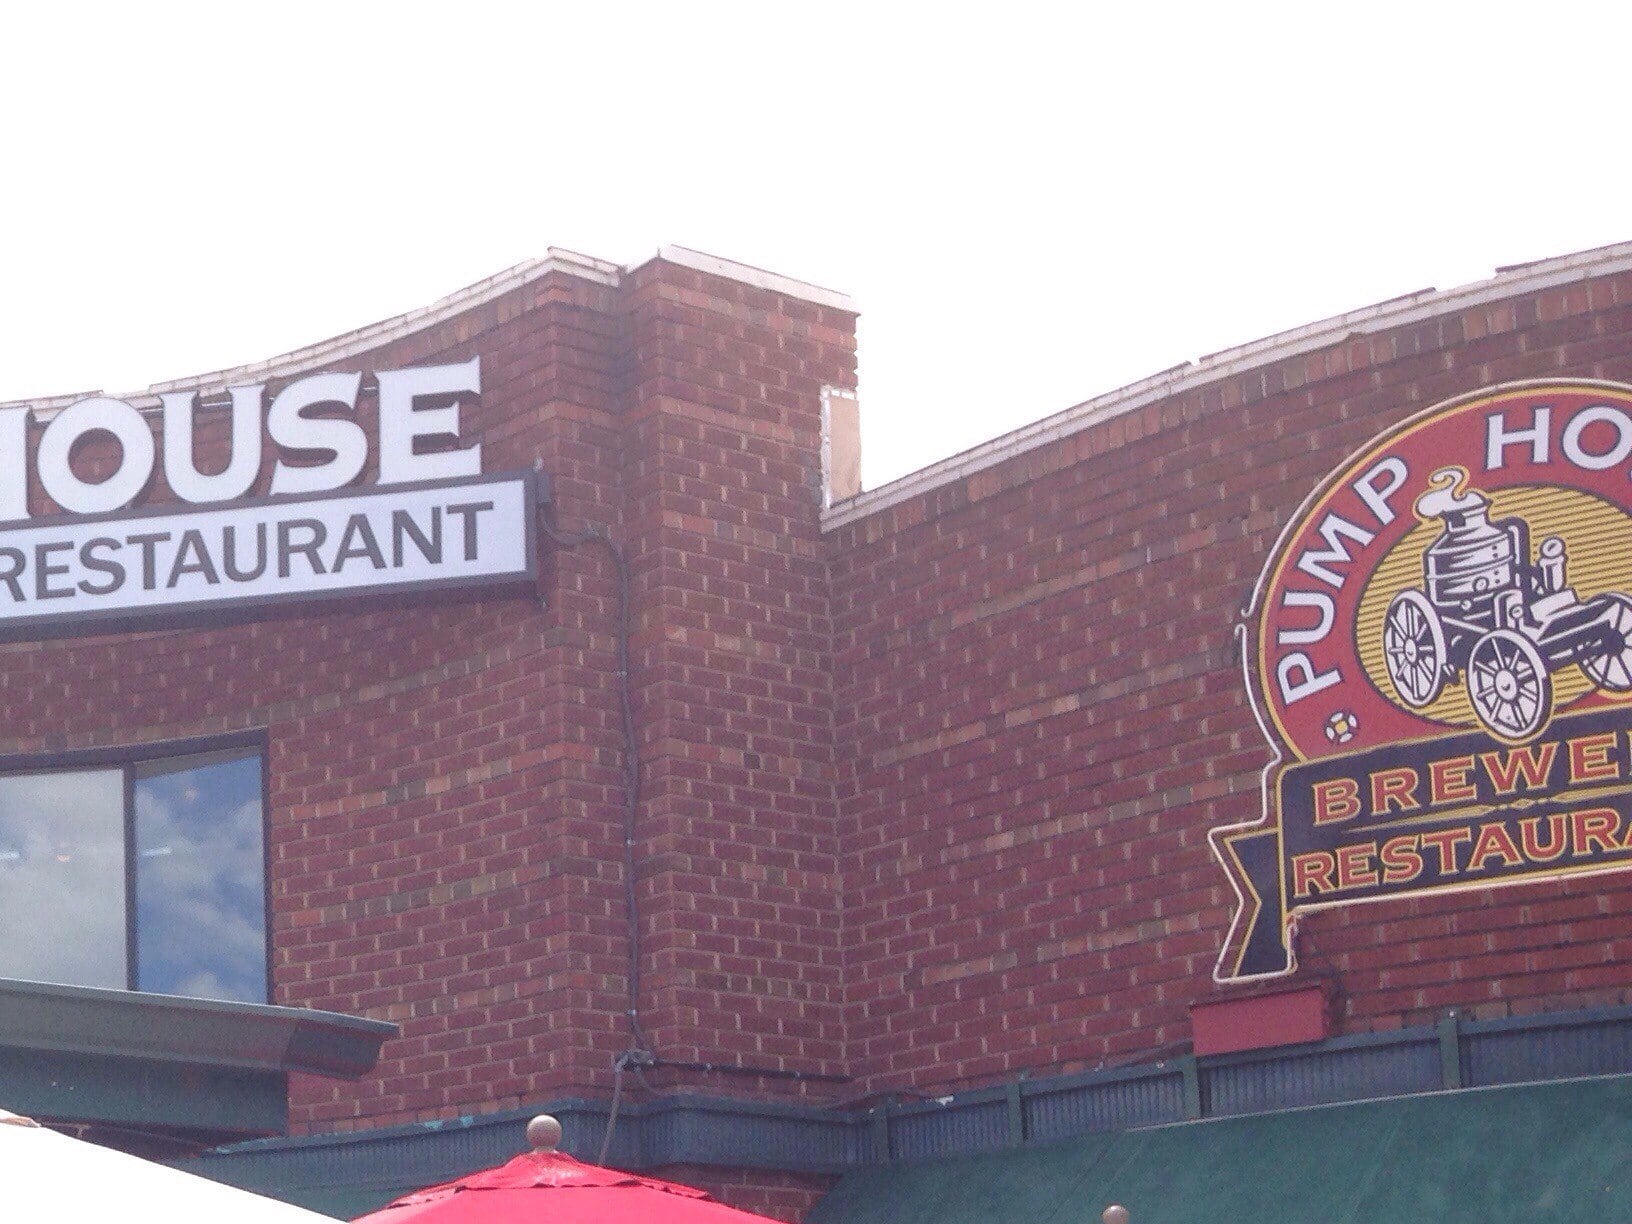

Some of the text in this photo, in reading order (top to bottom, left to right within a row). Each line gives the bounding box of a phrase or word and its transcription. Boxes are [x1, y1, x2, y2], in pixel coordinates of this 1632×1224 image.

[1277, 405, 1632, 706] PUMP HO
[1312, 731, 1632, 826] BREWE
[1291, 808, 1632, 898] RESTAUR
